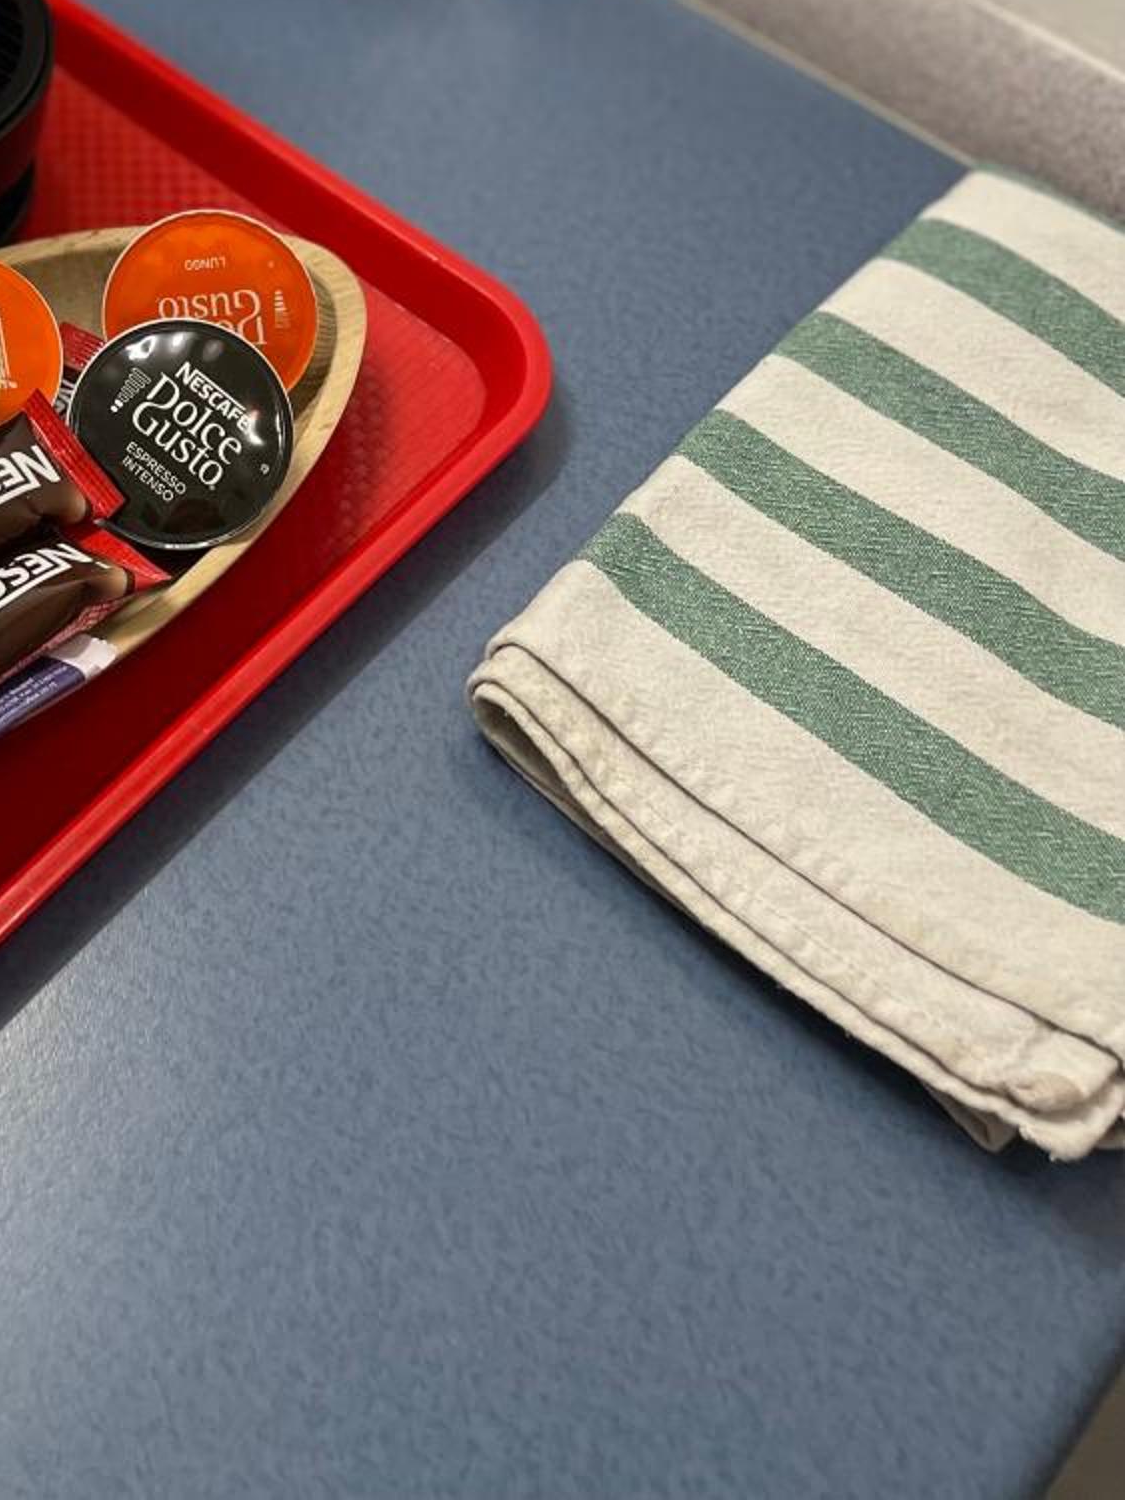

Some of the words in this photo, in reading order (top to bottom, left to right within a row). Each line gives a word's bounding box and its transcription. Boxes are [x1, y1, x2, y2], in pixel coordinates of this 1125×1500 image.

[184, 256, 226, 271] LUNGO
[132, 400, 225, 487] Gusto
[146, 371, 243, 465] Dolce
[122, 457, 174, 502] INTENSO
[125, 441, 186, 496] ESPRESSO
